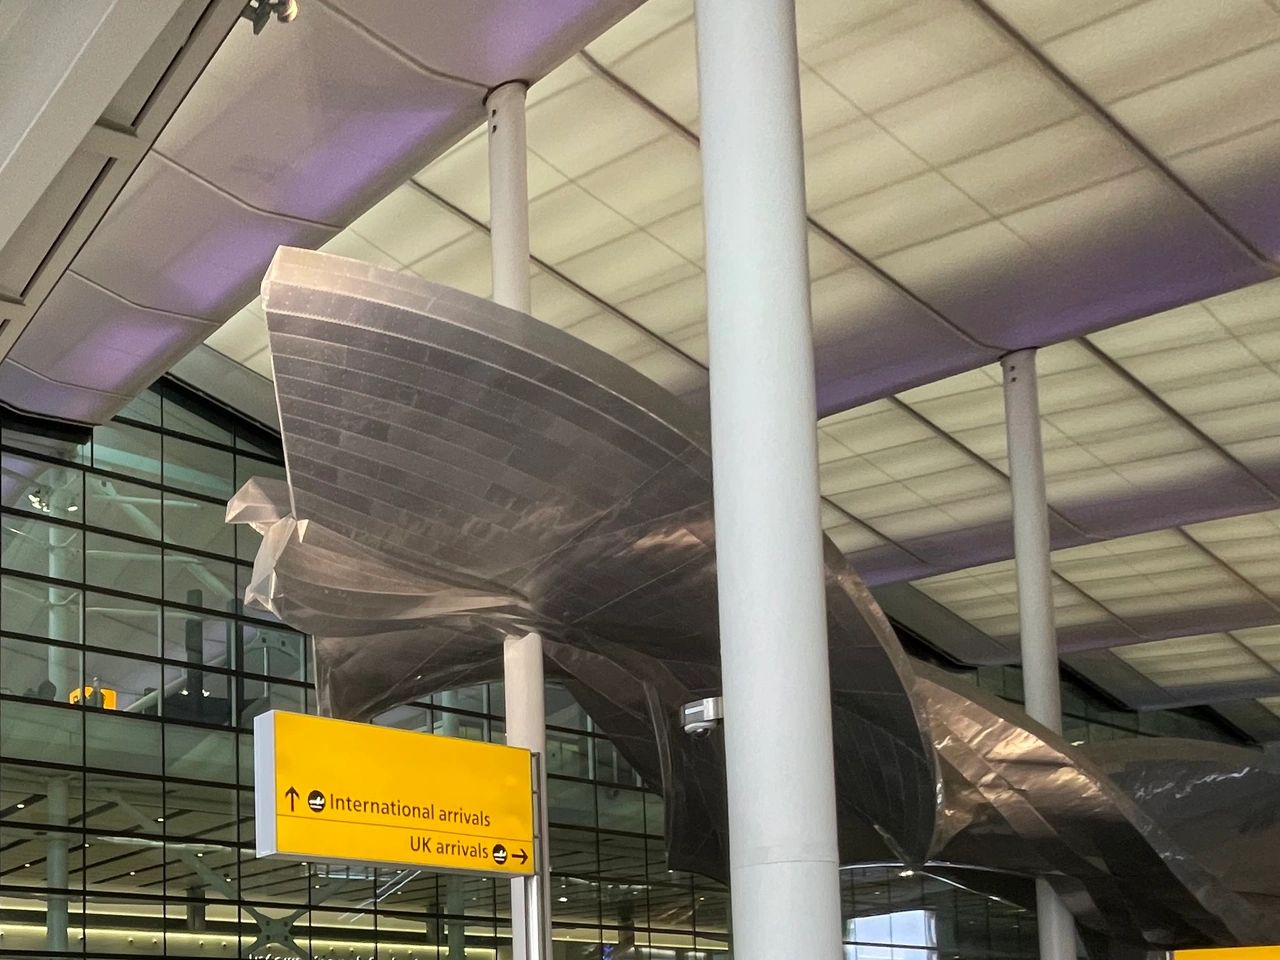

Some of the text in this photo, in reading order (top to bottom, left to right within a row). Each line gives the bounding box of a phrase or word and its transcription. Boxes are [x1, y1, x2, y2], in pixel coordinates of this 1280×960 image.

[329, 793, 491, 827] International arrivals
[410, 835, 489, 859] UK arrivals
